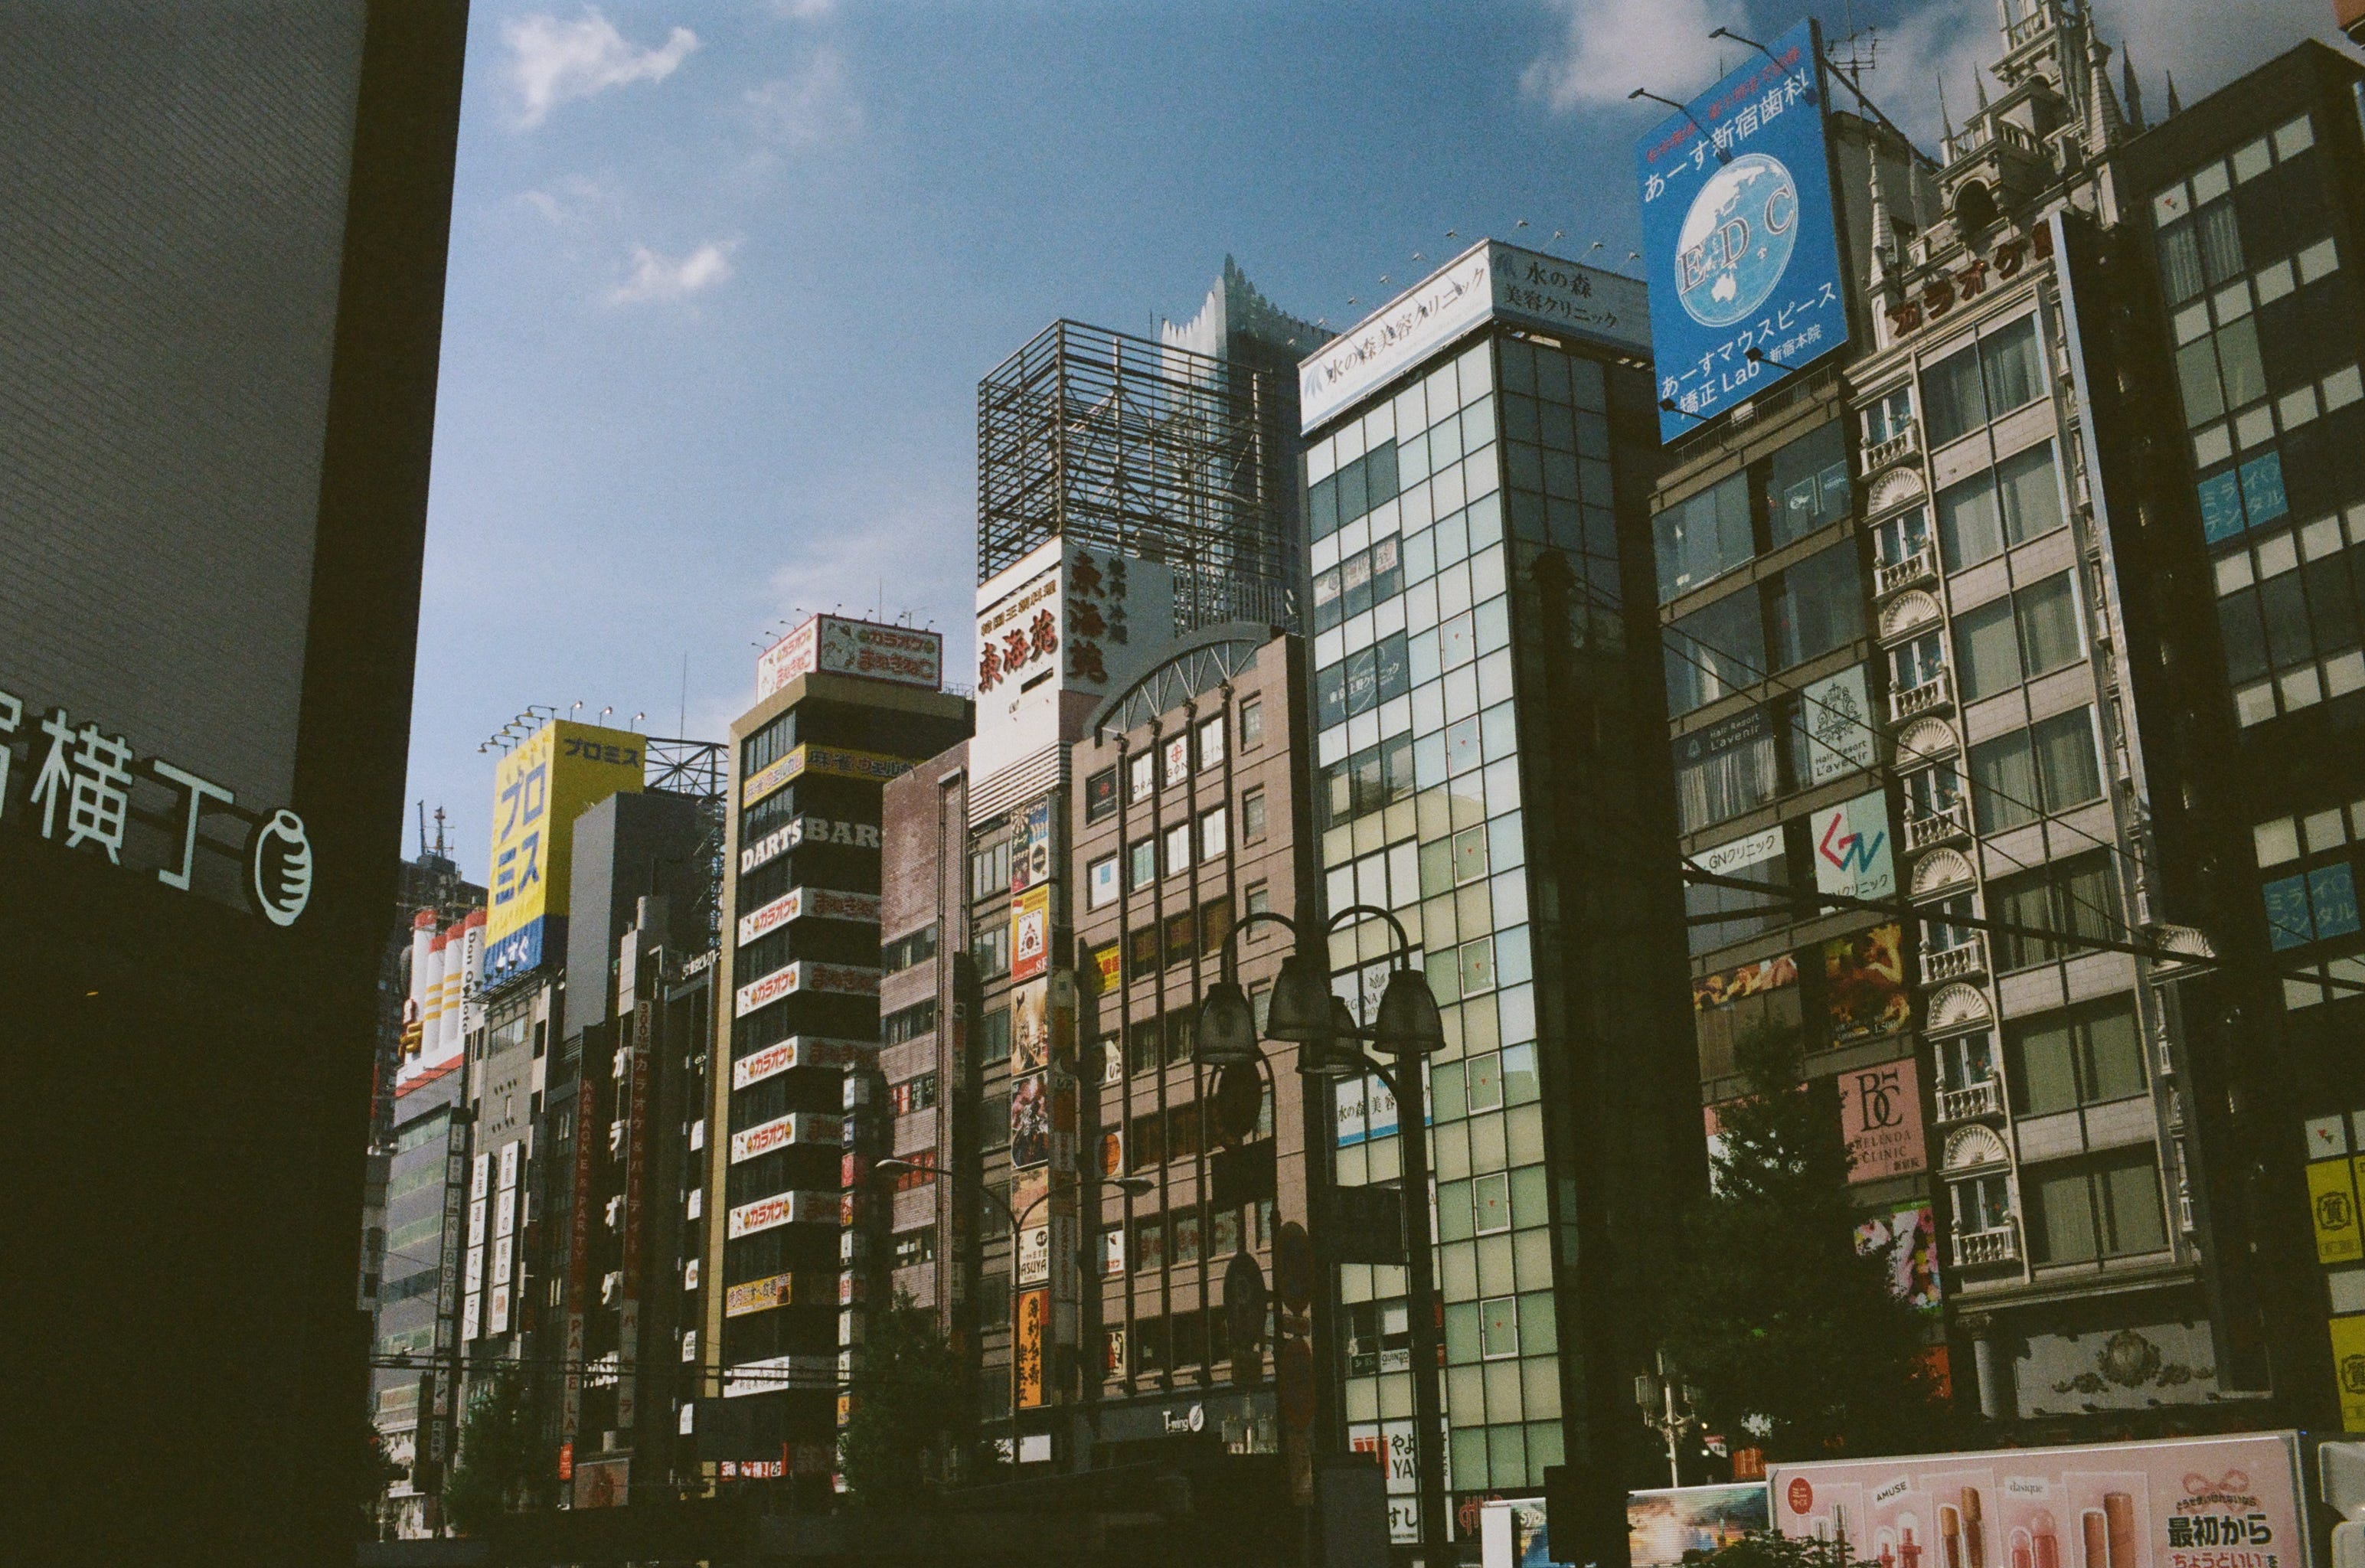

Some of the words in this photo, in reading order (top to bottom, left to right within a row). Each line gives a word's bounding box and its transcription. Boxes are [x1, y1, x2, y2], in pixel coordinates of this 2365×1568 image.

[1644, 68, 1809, 202] あーす新宿歯科
[1677, 184, 1795, 295] EDC
[1525, 261, 1592, 299] 水の森
[1505, 284, 1618, 329] 美容クリニック
[1327, 267, 1485, 386] 水の森美容クリニック
[1661, 282, 1836, 400] あーすマウスピース
[1769, 323, 1821, 364] 新宿本院
[1678, 381, 1717, 420] 矯正
[1723, 358, 1760, 394] Lab
[2206, 490, 2283, 533] デンタル
[782, 632, 806, 658] カラオケ
[869, 631, 923, 652] カラオケ
[776, 649, 811, 690] まねきねこ
[858, 648, 936, 681] まねきねこ
[1710, 725, 1729, 739] Hair
[1731, 713, 1760, 732] Resort
[563, 737, 639, 768] プロミス
[1815, 751, 1834, 765] Hair
[0, 693, 234, 890] 横丁
[501, 762, 547, 843] プロ
[741, 817, 802, 874] DARTS
[804, 817, 880, 848] BAR
[1709, 835, 1775, 868] GNクリニック
[495, 831, 540, 906] ミス
[759, 899, 791, 928] カラオケ
[466, 931, 476, 965] Don
[757, 974, 789, 1001] カラオケ
[755, 1047, 787, 1073] カラオケ
[580, 1080, 593, 1170] KARAOKE
[753, 1126, 785, 1151] カラオケ
[1862, 1146, 1906, 1162] CLINIC
[750, 1204, 782, 1226] カラオケ
[1021, 1259, 1047, 1276] ASUYA
[1162, 1411, 1189, 1431] T-wing
[1877, 1481, 1908, 1503] AMUSE
[2010, 1481, 2043, 1496] dasique
[2168, 1514, 2272, 1548] 最初から
